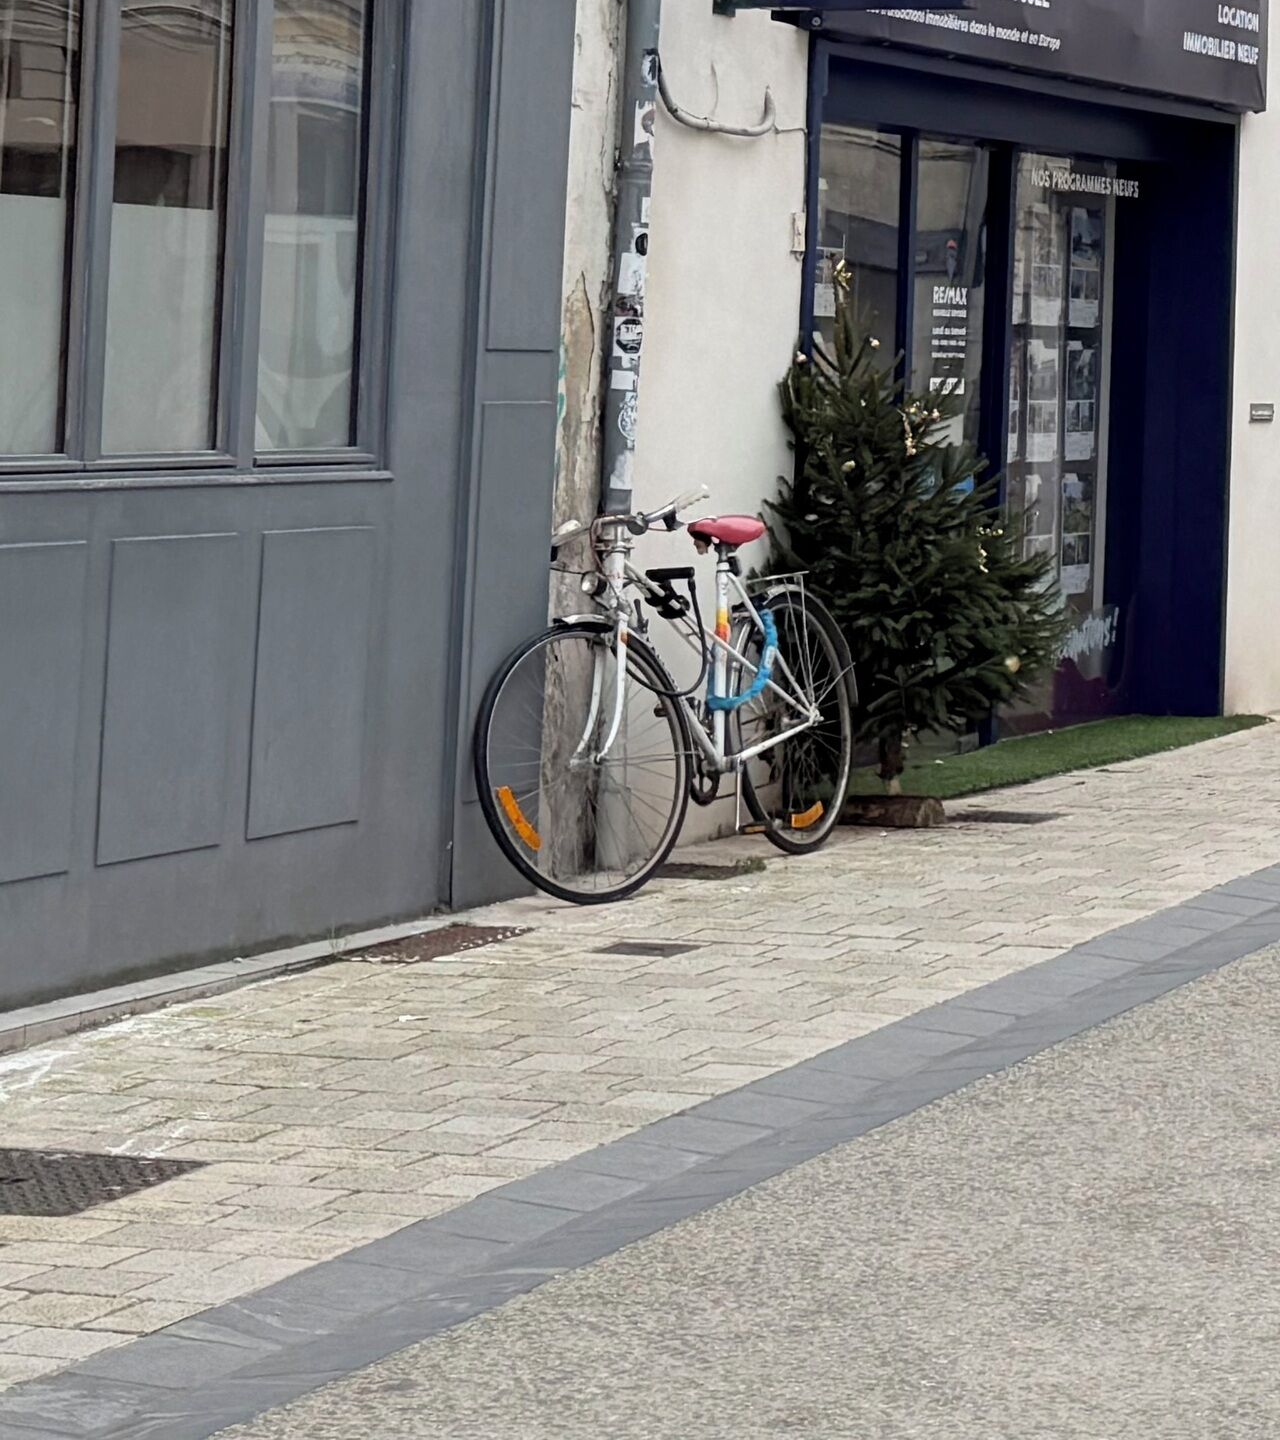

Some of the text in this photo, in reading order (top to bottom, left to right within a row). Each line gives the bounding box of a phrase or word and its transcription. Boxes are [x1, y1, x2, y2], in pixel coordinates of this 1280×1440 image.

[969, 20, 987, 36] dans
[988, 23, 995, 35] le
[995, 26, 1020, 41] monde
[1217, 4, 1259, 32] LOCATION
[1183, 31, 1259, 65] IMMOBILIER NEUF
[1031, 168, 1139, 198] NOS PROGRAMMES NEUFS
[933, 286, 967, 305] RE/MAX
